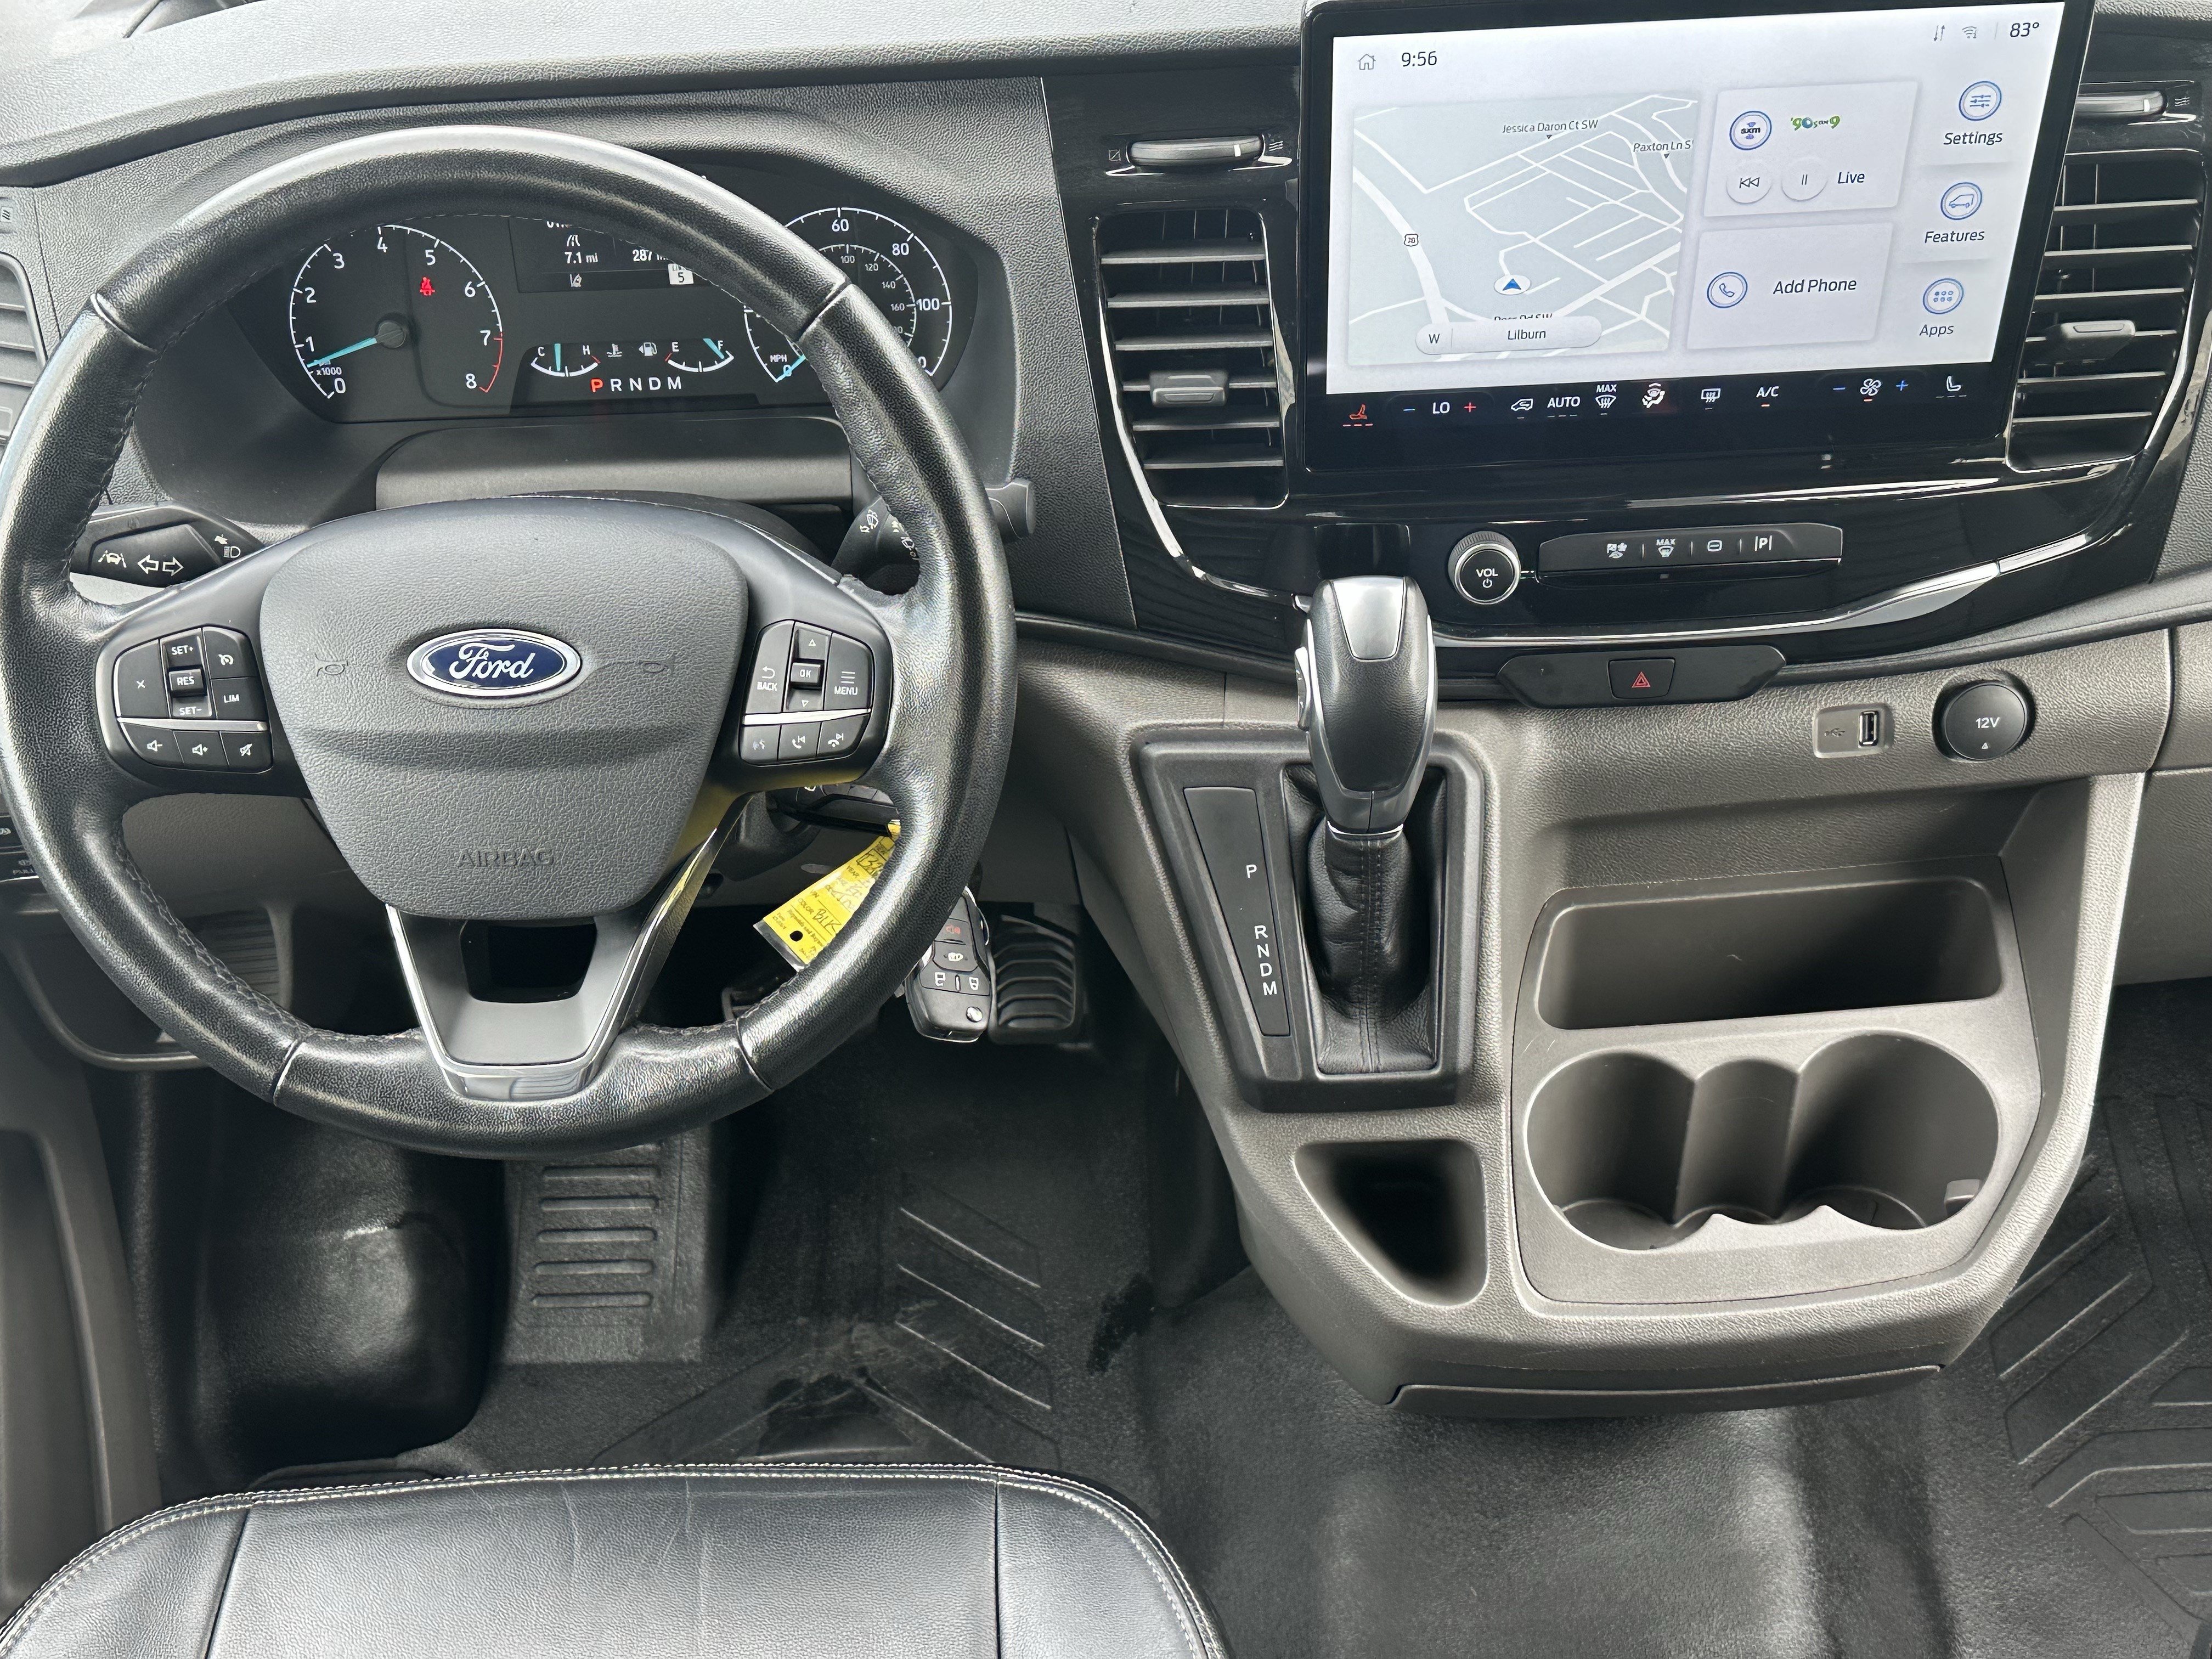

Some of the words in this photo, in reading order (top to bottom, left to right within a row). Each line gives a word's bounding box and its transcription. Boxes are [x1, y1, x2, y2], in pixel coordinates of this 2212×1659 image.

[1401, 51, 1438, 67] 9:56
[1502, 123, 1535, 133] Jessica
[1537, 122, 1567, 132] Daron
[1568, 121, 1580, 130] Ct
[1581, 119, 1599, 129] SW
[1943, 131, 2003, 145] Settings
[1633, 142, 1669, 153] Paxton
[1671, 141, 1683, 150] Ln
[1685, 140, 1694, 149] S
[1837, 171, 1865, 184] Live
[832, 218, 849, 232] 60
[1924, 230, 1985, 244] Features
[377, 237, 388, 253] 4
[892, 242, 910, 256] 80
[333, 253, 345, 269] 3
[425, 250, 436, 266] 5
[564, 251, 582, 263] 7.1
[586, 252, 598, 263] mi
[632, 249, 652, 262] 287
[840, 255, 855, 263] 100
[865, 263, 879, 272] 120
[678, 272, 685, 283] 5
[465, 281, 476, 298] 6
[882, 281, 896, 290] 140
[1773, 279, 1804, 295] Add
[1808, 279, 1857, 293] Phone
[304, 287, 317, 303] 2
[890, 303, 905, 311] 160
[916, 298, 940, 311] 100
[1508, 330, 1546, 340] Lilburn
[1919, 324, 1954, 337] Apps
[305, 336, 314, 352] 1
[480, 330, 490, 346] 7
[1429, 334, 1440, 344] W
[538, 347, 545, 357] C
[583, 345, 590, 355] H
[672, 342, 680, 352] E
[717, 340, 724, 351] F
[770, 354, 787, 362] MPH
[334, 377, 346, 393] 0
[465, 373, 477, 389] 8
[590, 378, 603, 392] P
[611, 379, 622, 391] R
[630, 377, 642, 391] N
[648, 377, 661, 391] D
[668, 376, 682, 390] M
[1596, 384, 1617, 393] MAX
[1756, 386, 1780, 398] A/C
[1432, 402, 1451, 415] LO
[1547, 396, 1581, 408] AUTO
[1476, 568, 1499, 578] VOL
[449, 642, 534, 679] Ford
[800, 669, 811, 678] OK
[177, 676, 195, 685] RES
[757, 682, 777, 691] BACK
[834, 686, 857, 695] MENU
[224, 694, 240, 703] LIM
[1976, 716, 2000, 729] 12V
[458, 848, 554, 867] AIRBAG
[1246, 865, 1257, 878] P
[1254, 925, 1268, 940] R
[1257, 945, 1270, 958] N
[1260, 963, 1272, 977] D
[1263, 981, 1277, 996] M
